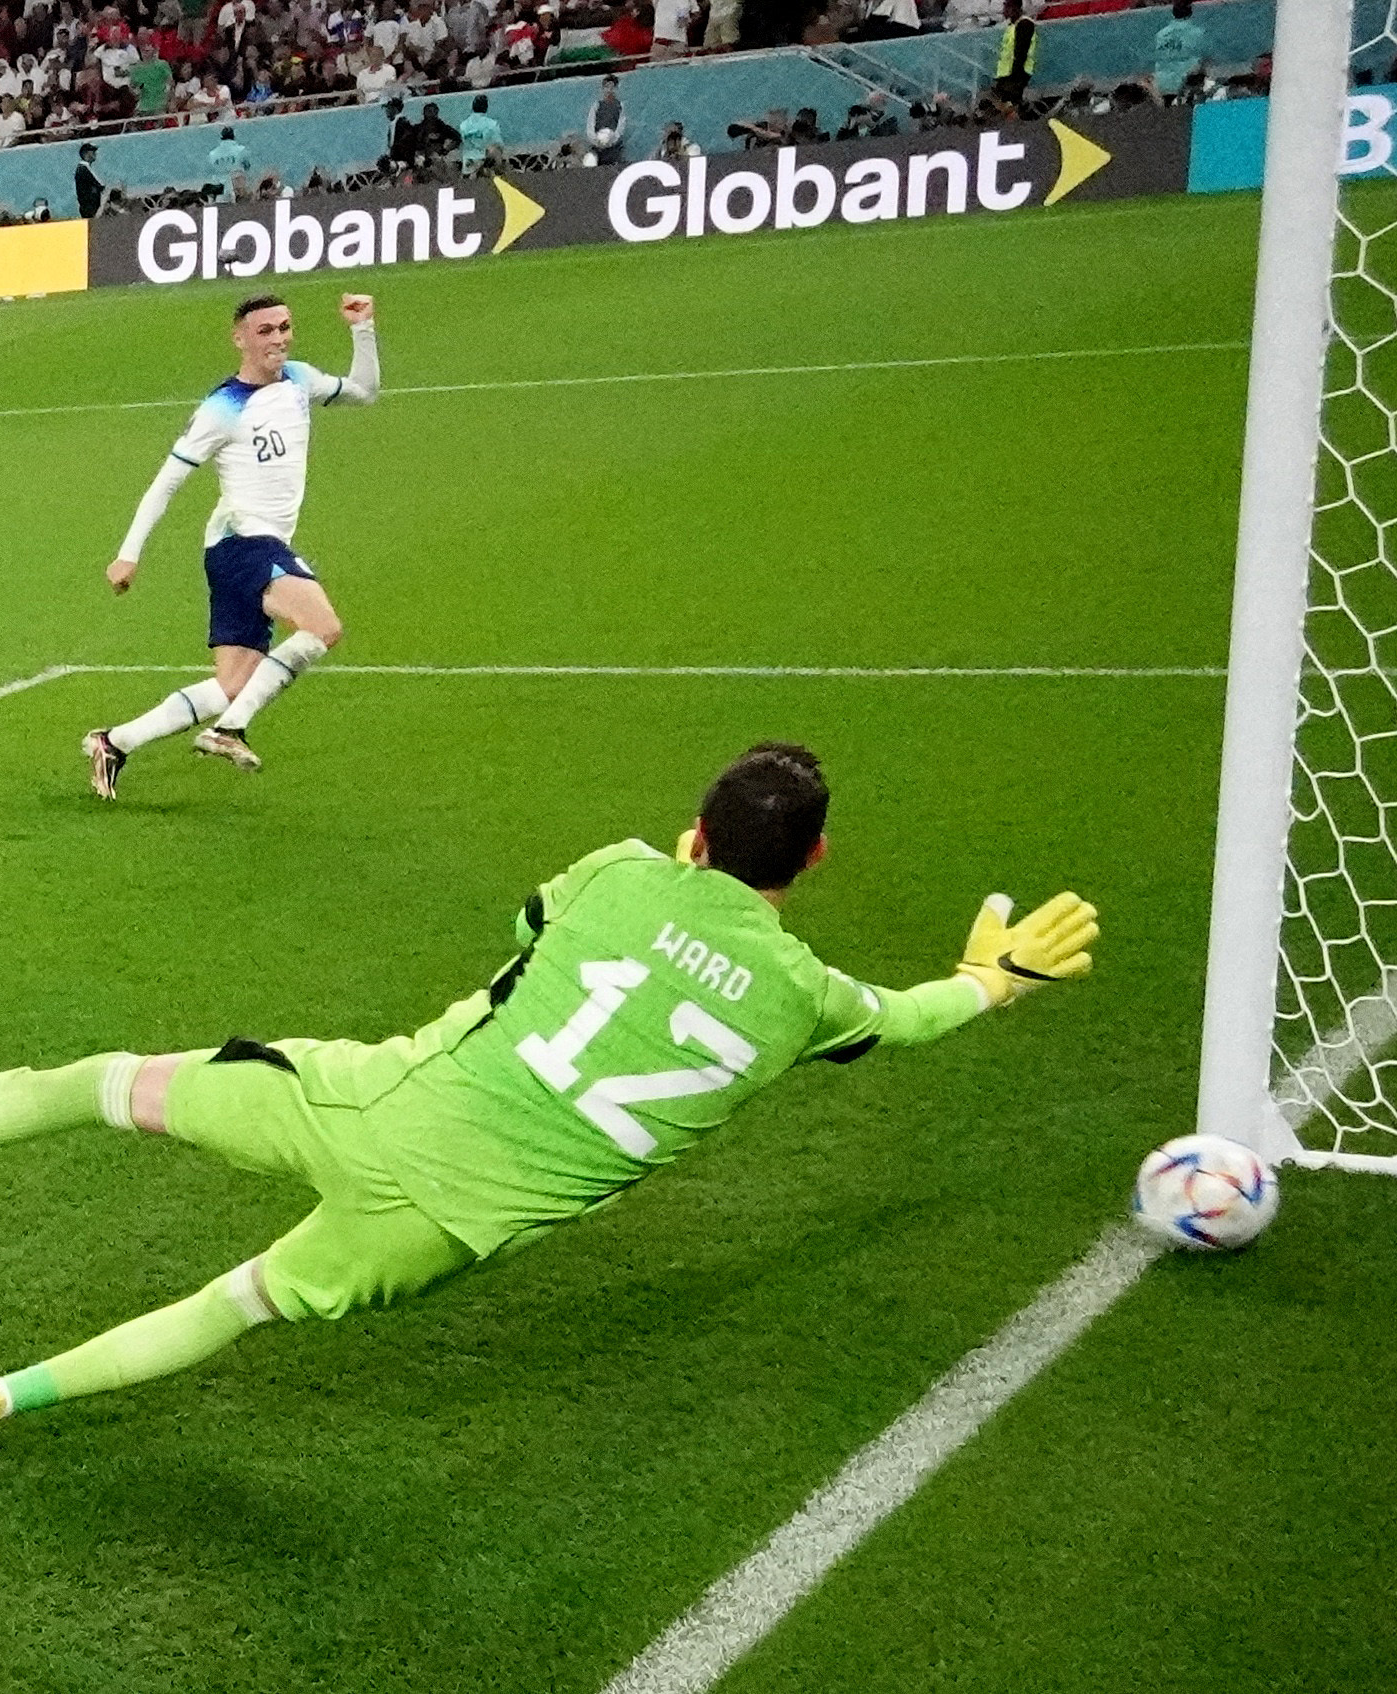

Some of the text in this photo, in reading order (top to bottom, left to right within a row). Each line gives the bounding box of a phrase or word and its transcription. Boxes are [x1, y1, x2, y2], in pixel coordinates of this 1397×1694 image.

[608, 131, 1032, 242] Globant
[138, 187, 482, 284] Globant
[253, 429, 286, 463] 20
[650, 921, 753, 1001] WARD
[514, 956, 758, 1160] 12
